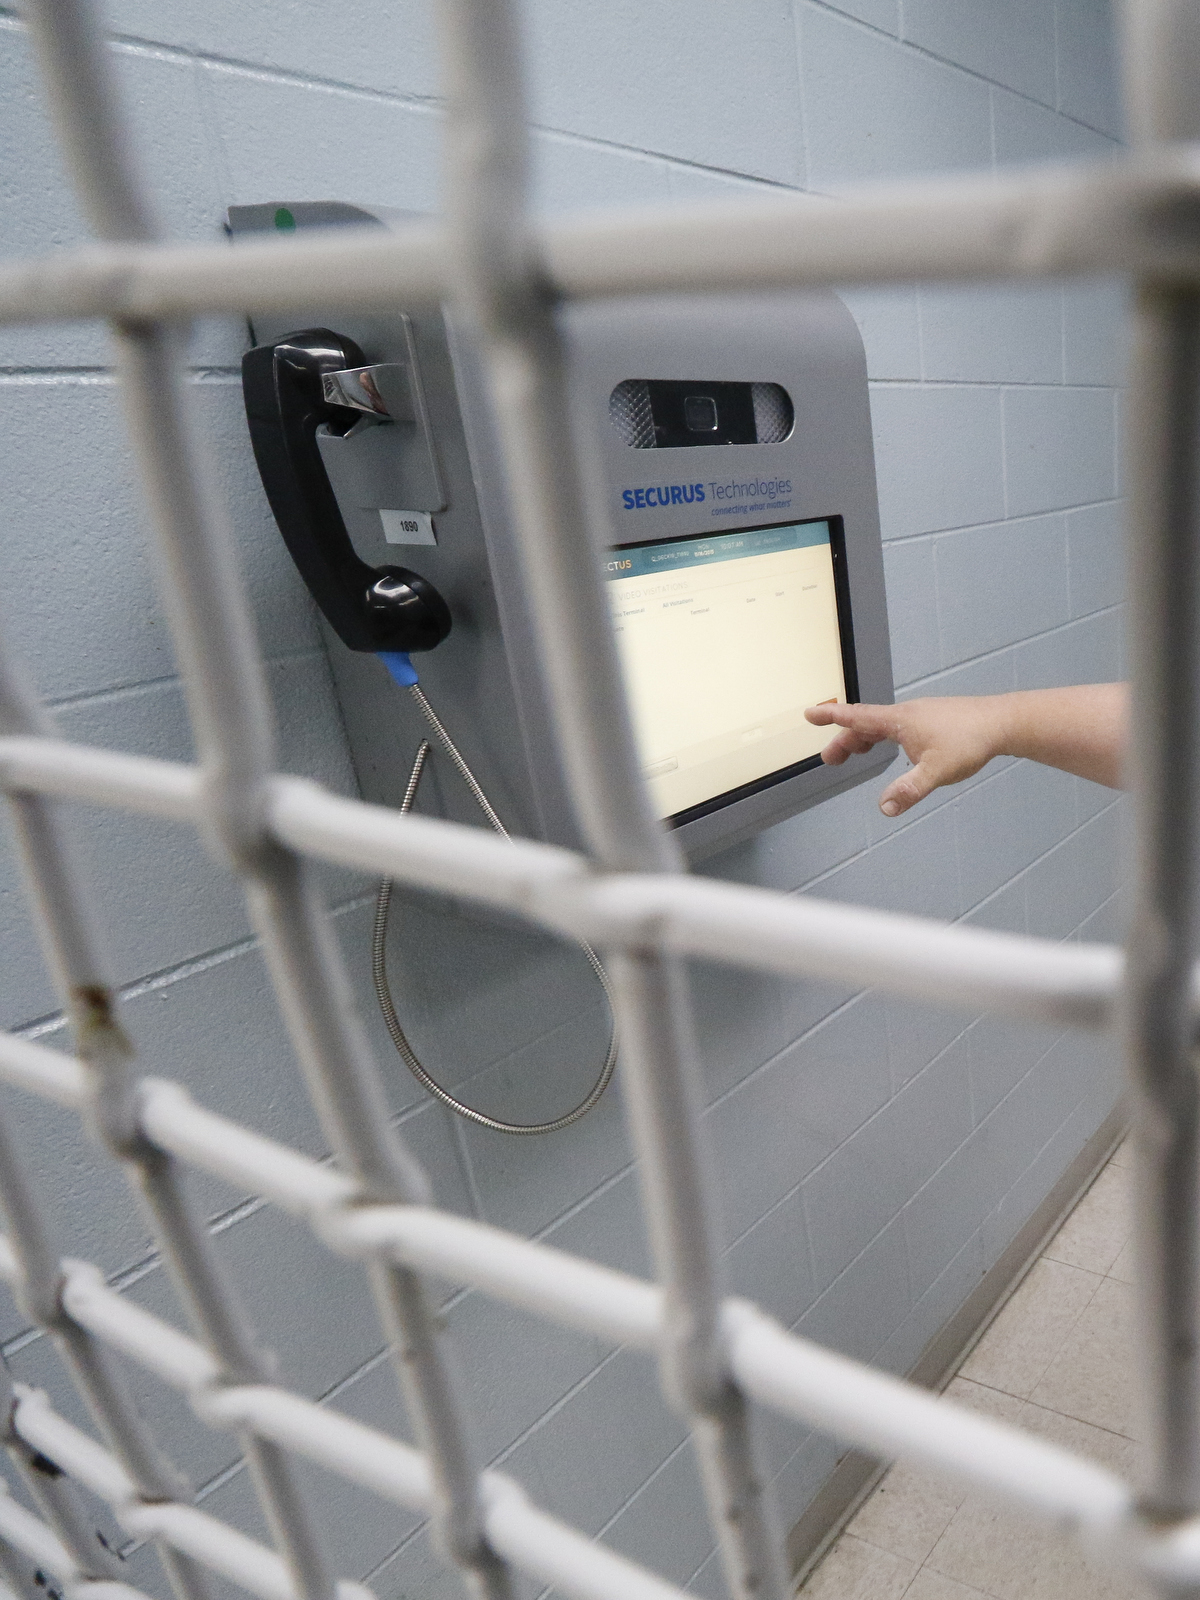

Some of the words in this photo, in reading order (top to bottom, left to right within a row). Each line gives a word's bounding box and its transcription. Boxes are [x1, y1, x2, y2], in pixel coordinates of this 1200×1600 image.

[622, 483, 706, 510] SECURUS
[708, 477, 792, 500] Technologies
[711, 504, 748, 516] connecting
[749, 502, 766, 512] what
[400, 520, 419, 532] 1890
[619, 590, 641, 601] VIDEO
[643, 581, 689, 597] VISITATIONS
[670, 598, 694, 607] Visitations
[623, 608, 646, 617] Terminal
